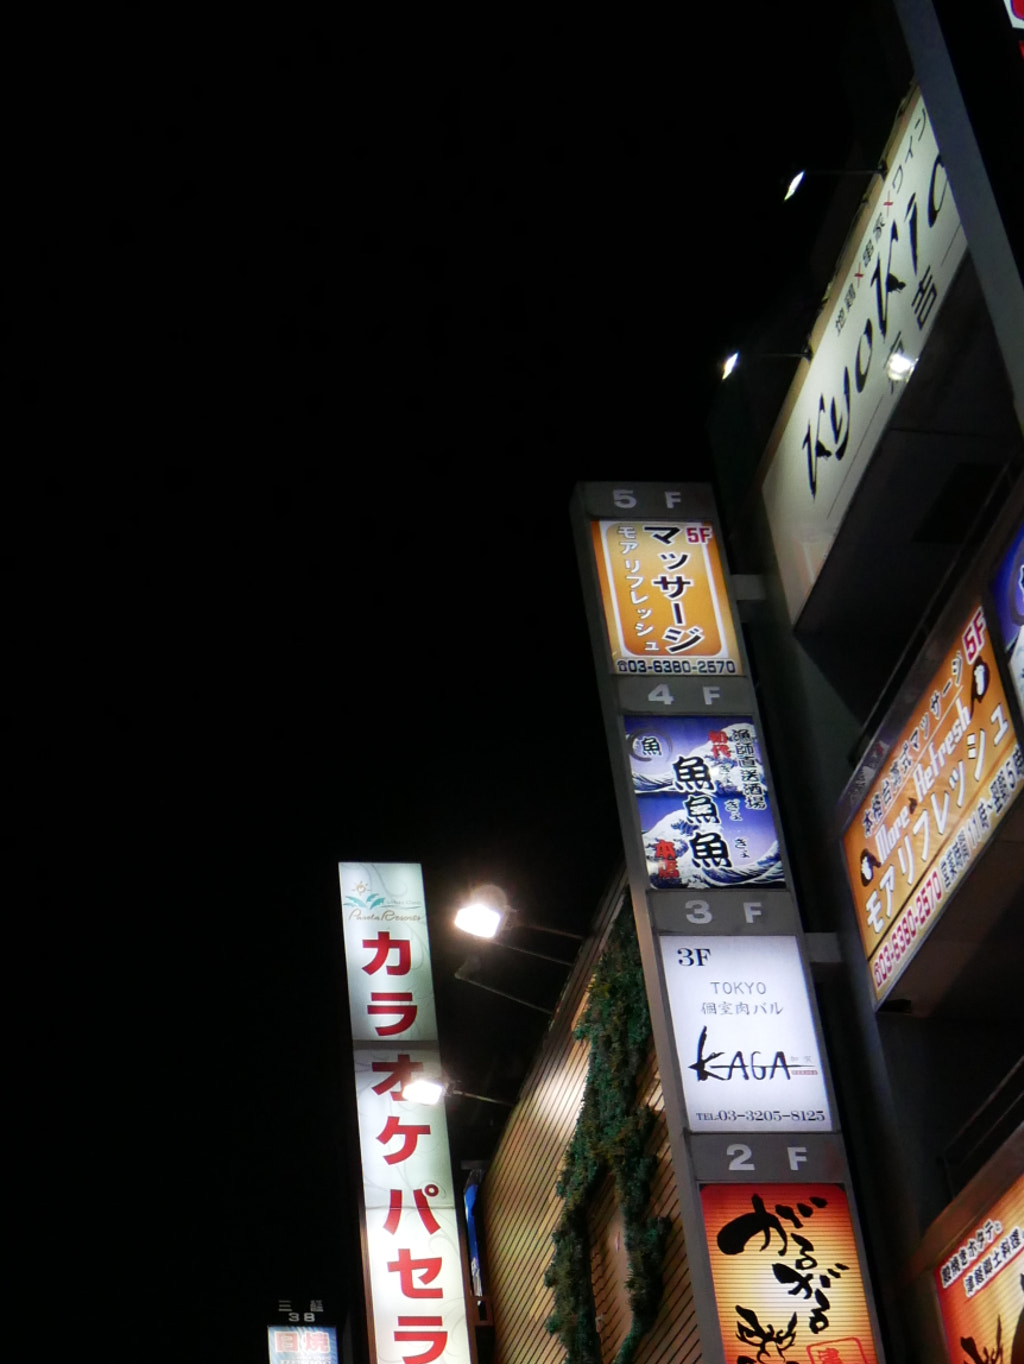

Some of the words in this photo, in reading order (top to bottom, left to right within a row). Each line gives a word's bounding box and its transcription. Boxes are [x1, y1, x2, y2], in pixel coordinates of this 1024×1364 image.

[686, 525, 712, 544] 5F
[644, 524, 705, 654] マッサージ
[865, 703, 1010, 934] モアリフレッシュ
[676, 947, 712, 968] 3F
[710, 980, 767, 996] TOKYO
